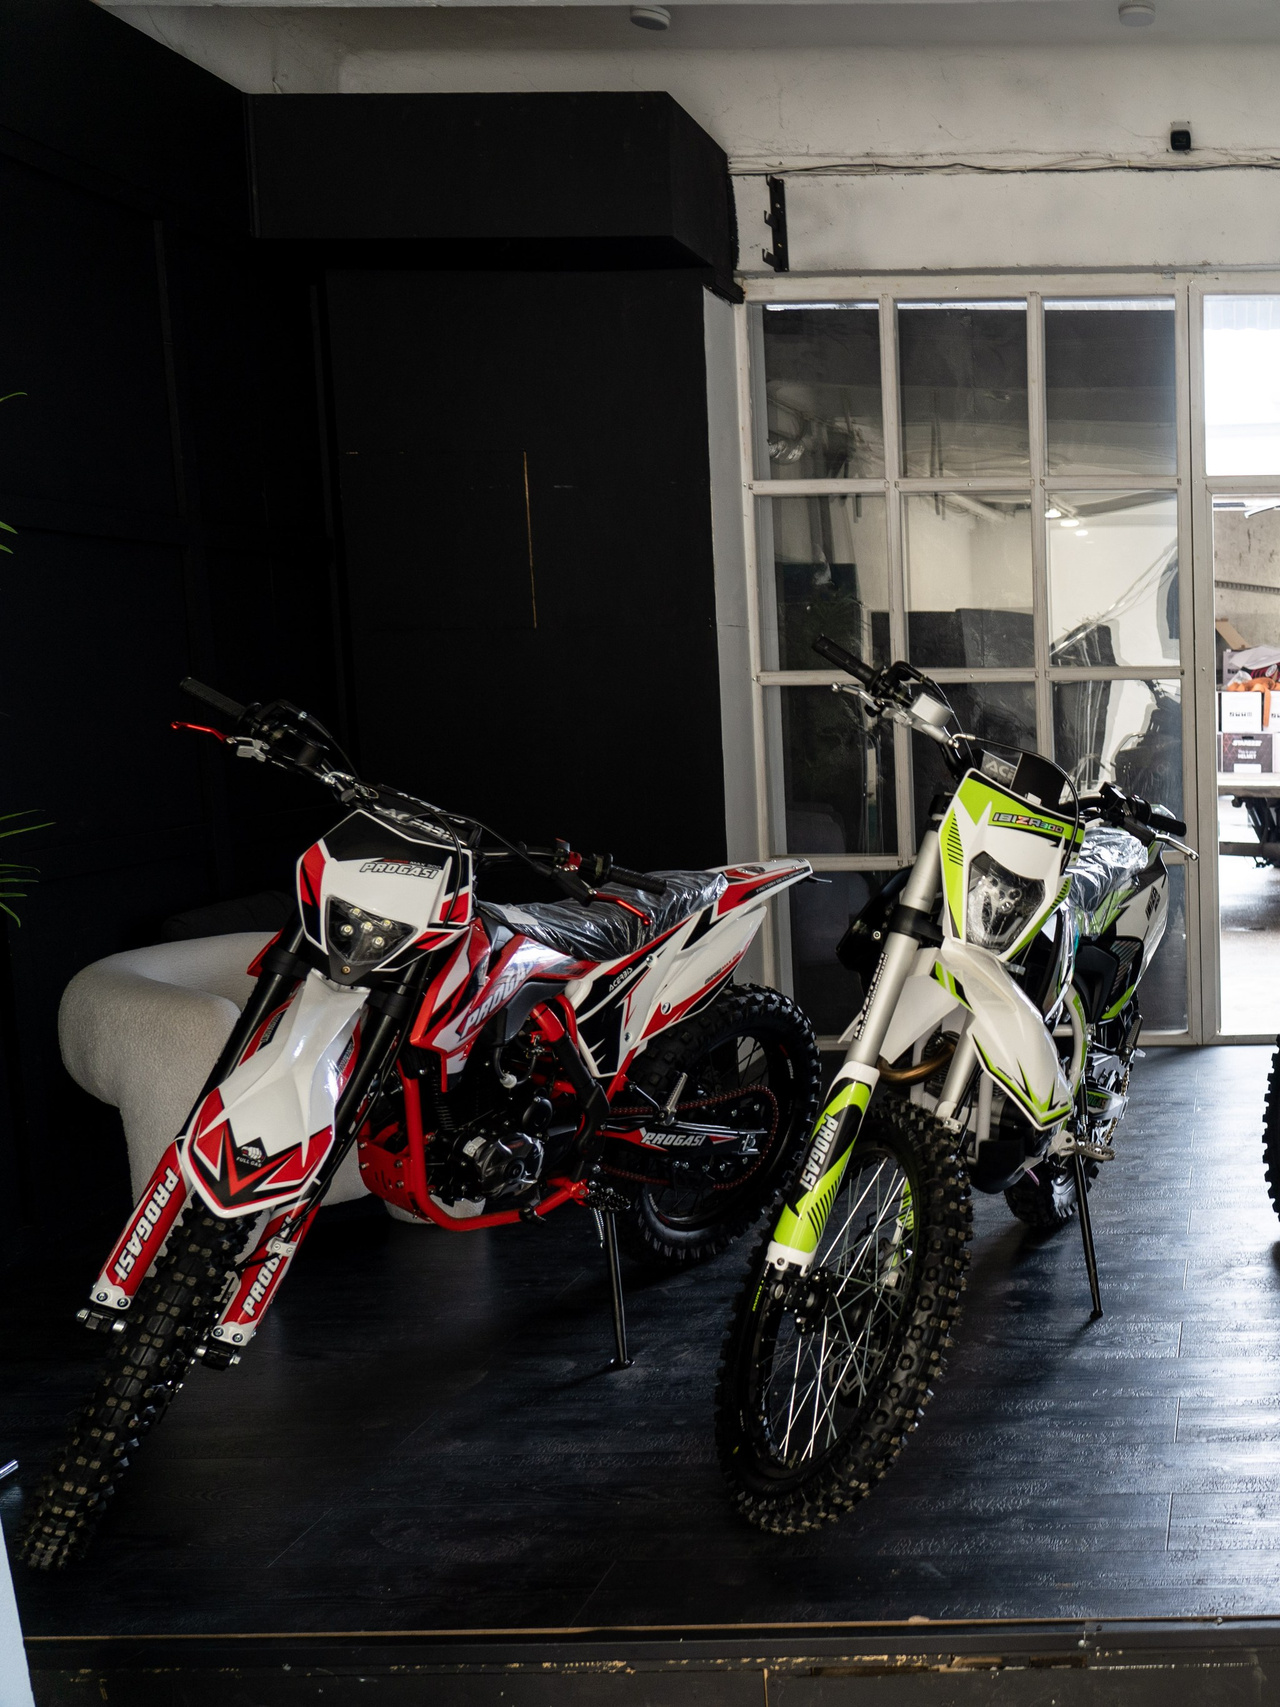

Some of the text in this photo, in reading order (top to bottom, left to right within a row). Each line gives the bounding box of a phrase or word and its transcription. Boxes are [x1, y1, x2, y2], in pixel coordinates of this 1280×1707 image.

[360, 862, 442, 880] PROGASI
[640, 1132, 707, 1147] PROGASI
[800, 1113, 840, 1192] PROGASI
[235, 1156, 264, 1169] FULL GAS
[112, 1166, 180, 1281] PROGASI
